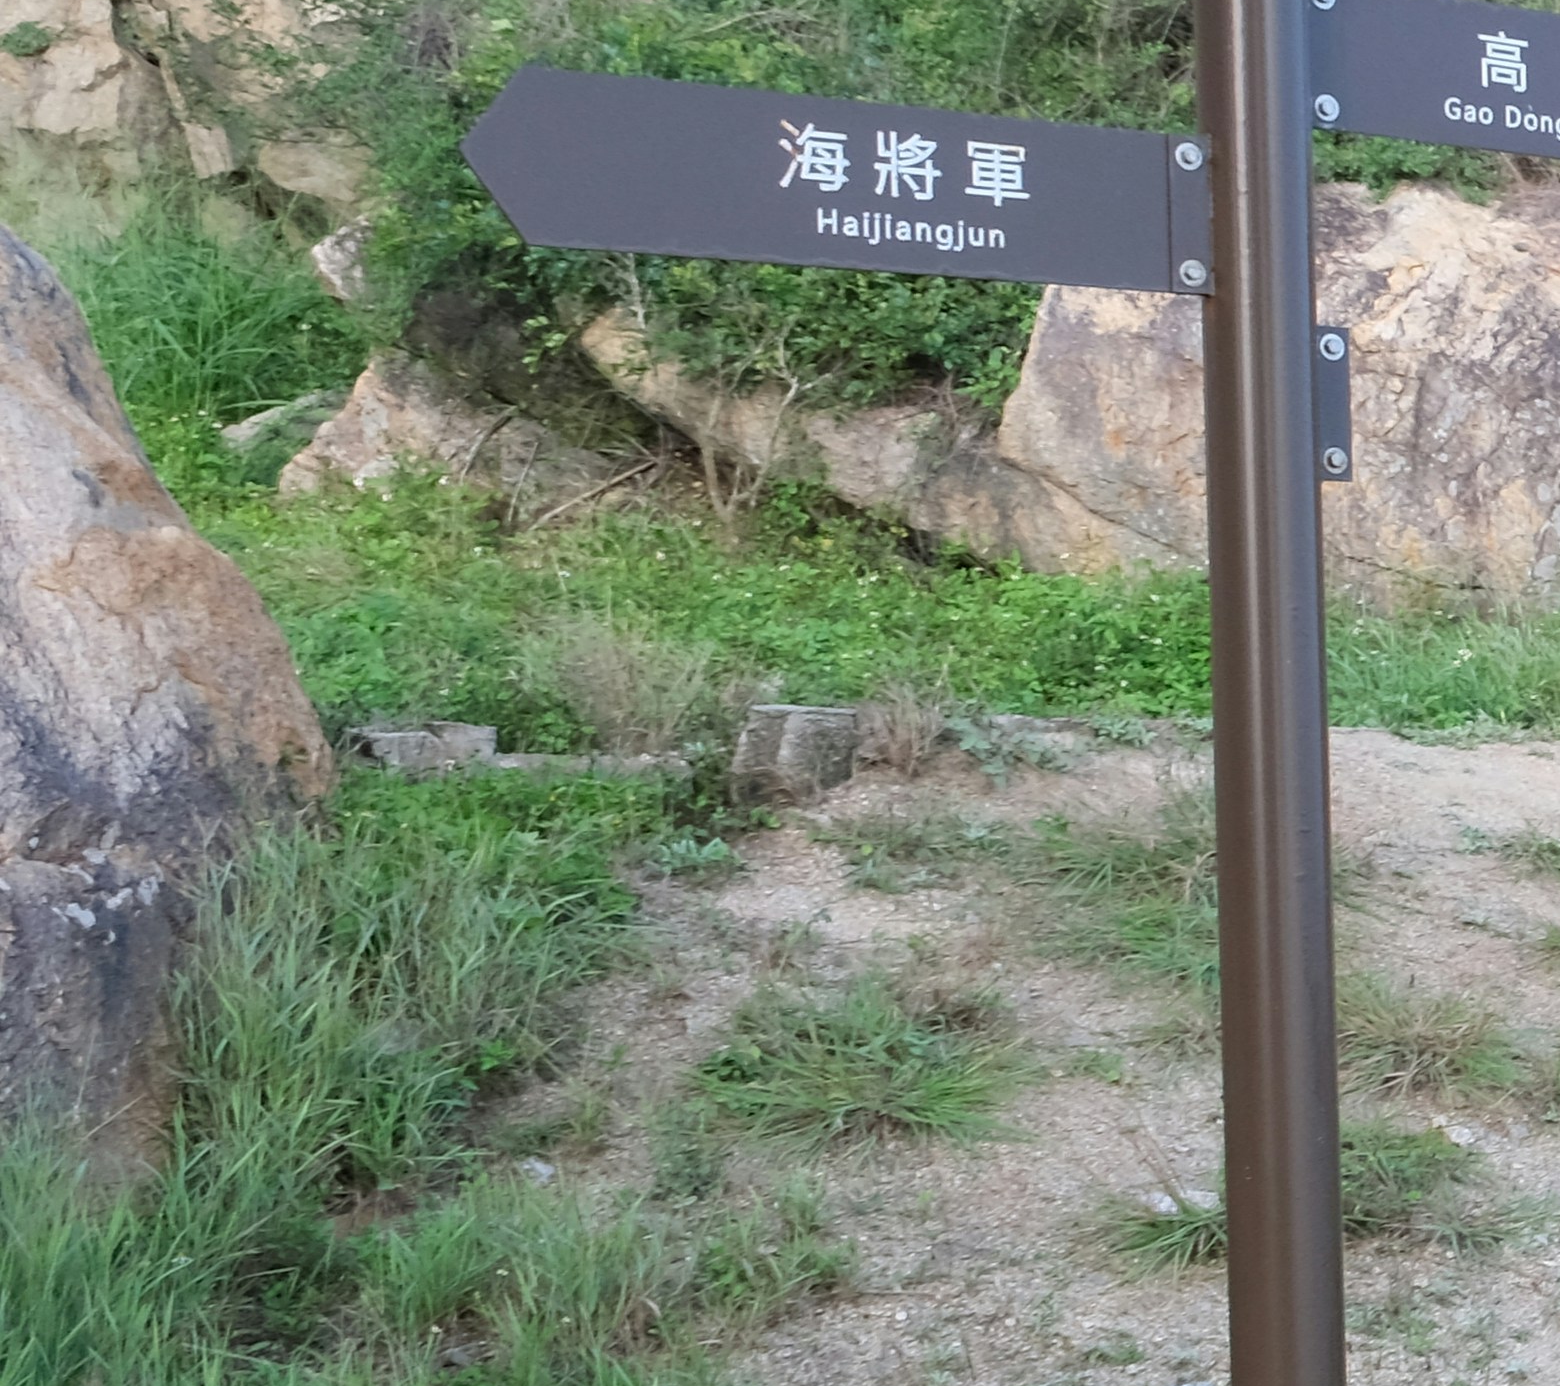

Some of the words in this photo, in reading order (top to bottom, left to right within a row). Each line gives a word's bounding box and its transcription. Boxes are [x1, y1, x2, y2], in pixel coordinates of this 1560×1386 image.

[1444, 97, 1494, 125] Gao
[778, 119, 1031, 207] 海將軍
[816, 207, 1006, 252] Haijiangjun
